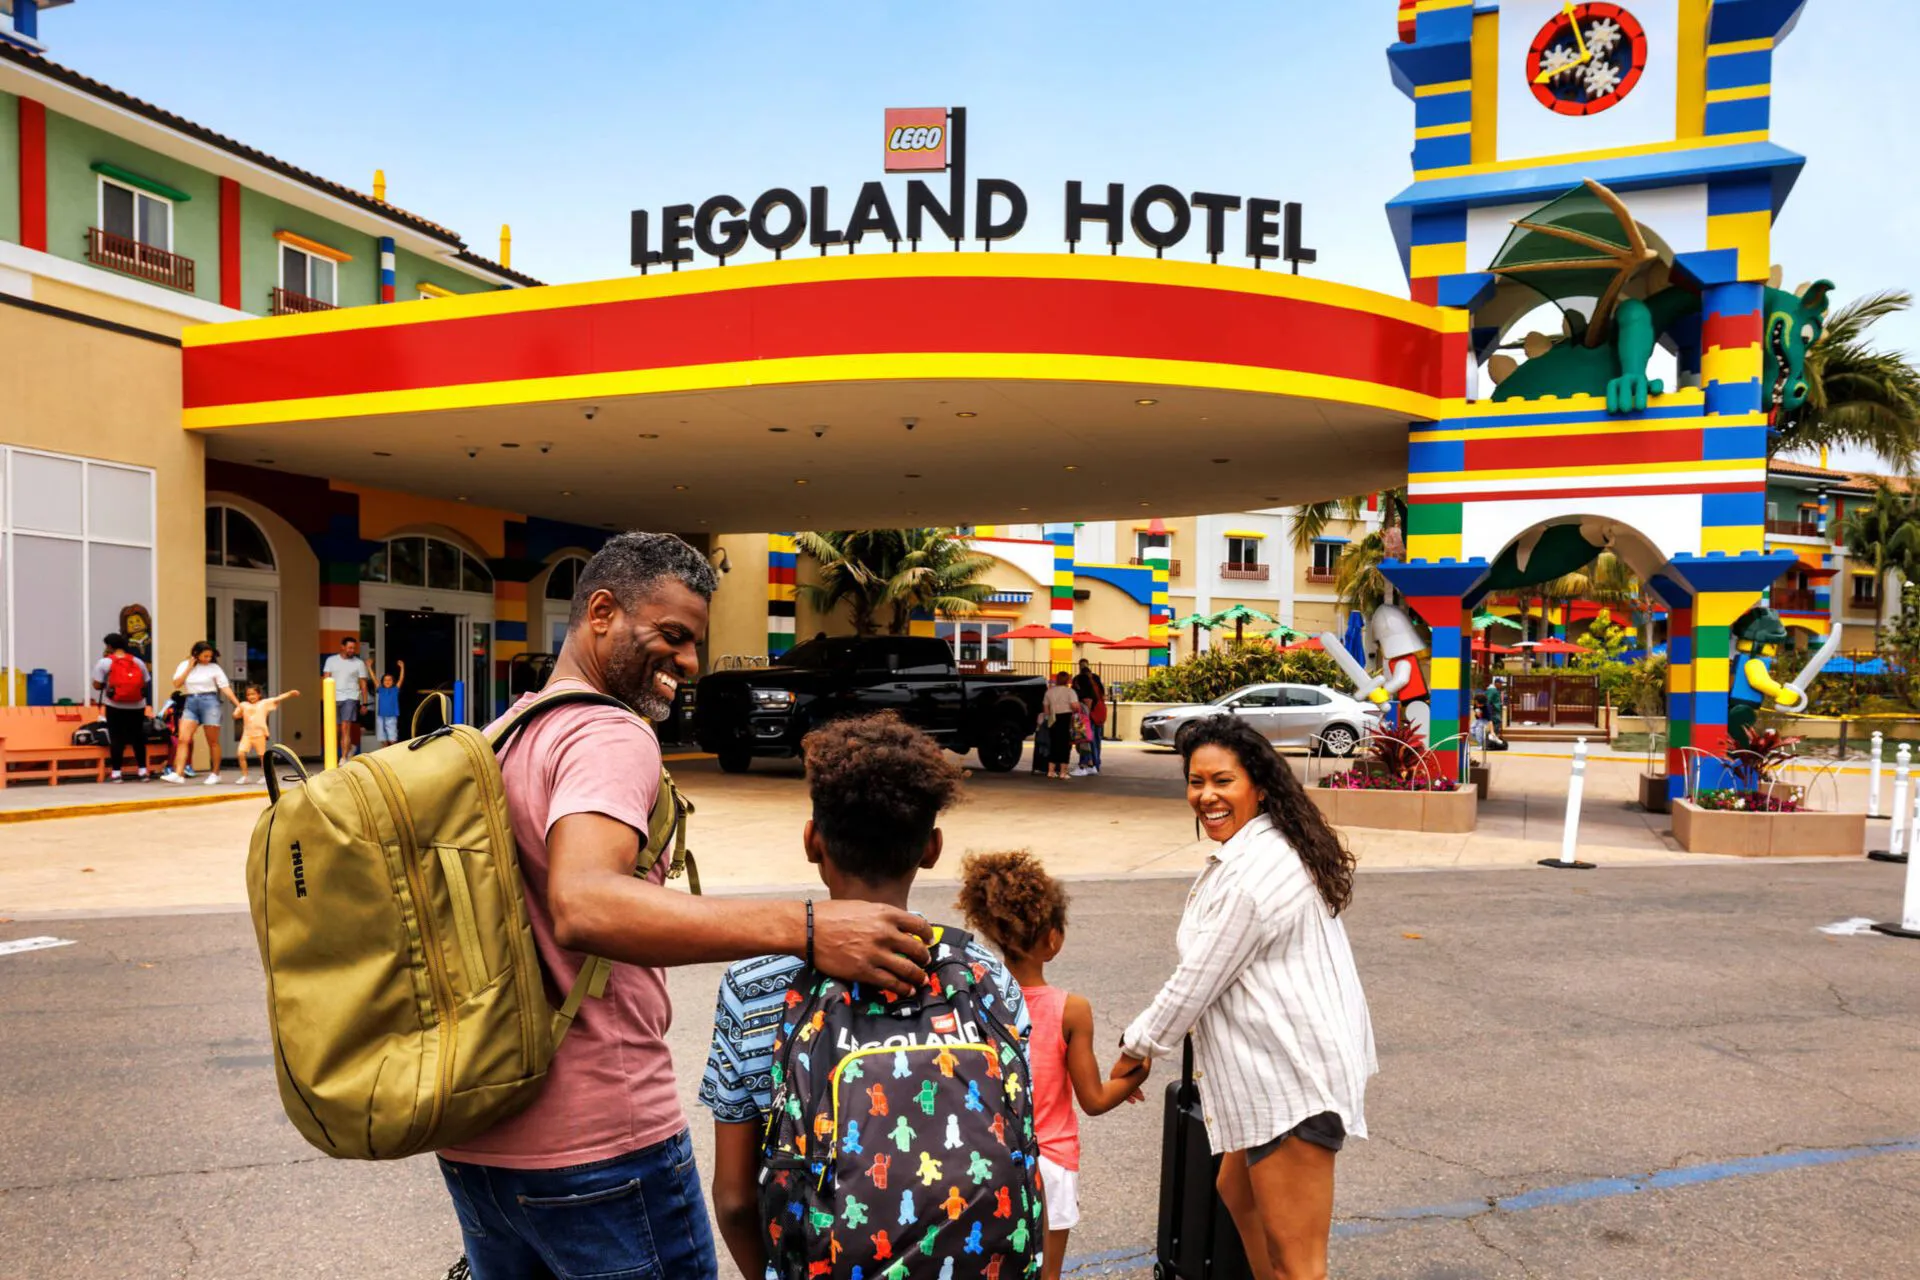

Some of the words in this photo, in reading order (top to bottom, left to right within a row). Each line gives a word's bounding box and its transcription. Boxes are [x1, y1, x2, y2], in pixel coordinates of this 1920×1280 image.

[888, 125, 943, 152] LEGO
[631, 178, 1028, 266] LEGOLAND
[1064, 180, 1316, 263] HOTEL
[290, 840, 307, 898] THULE
